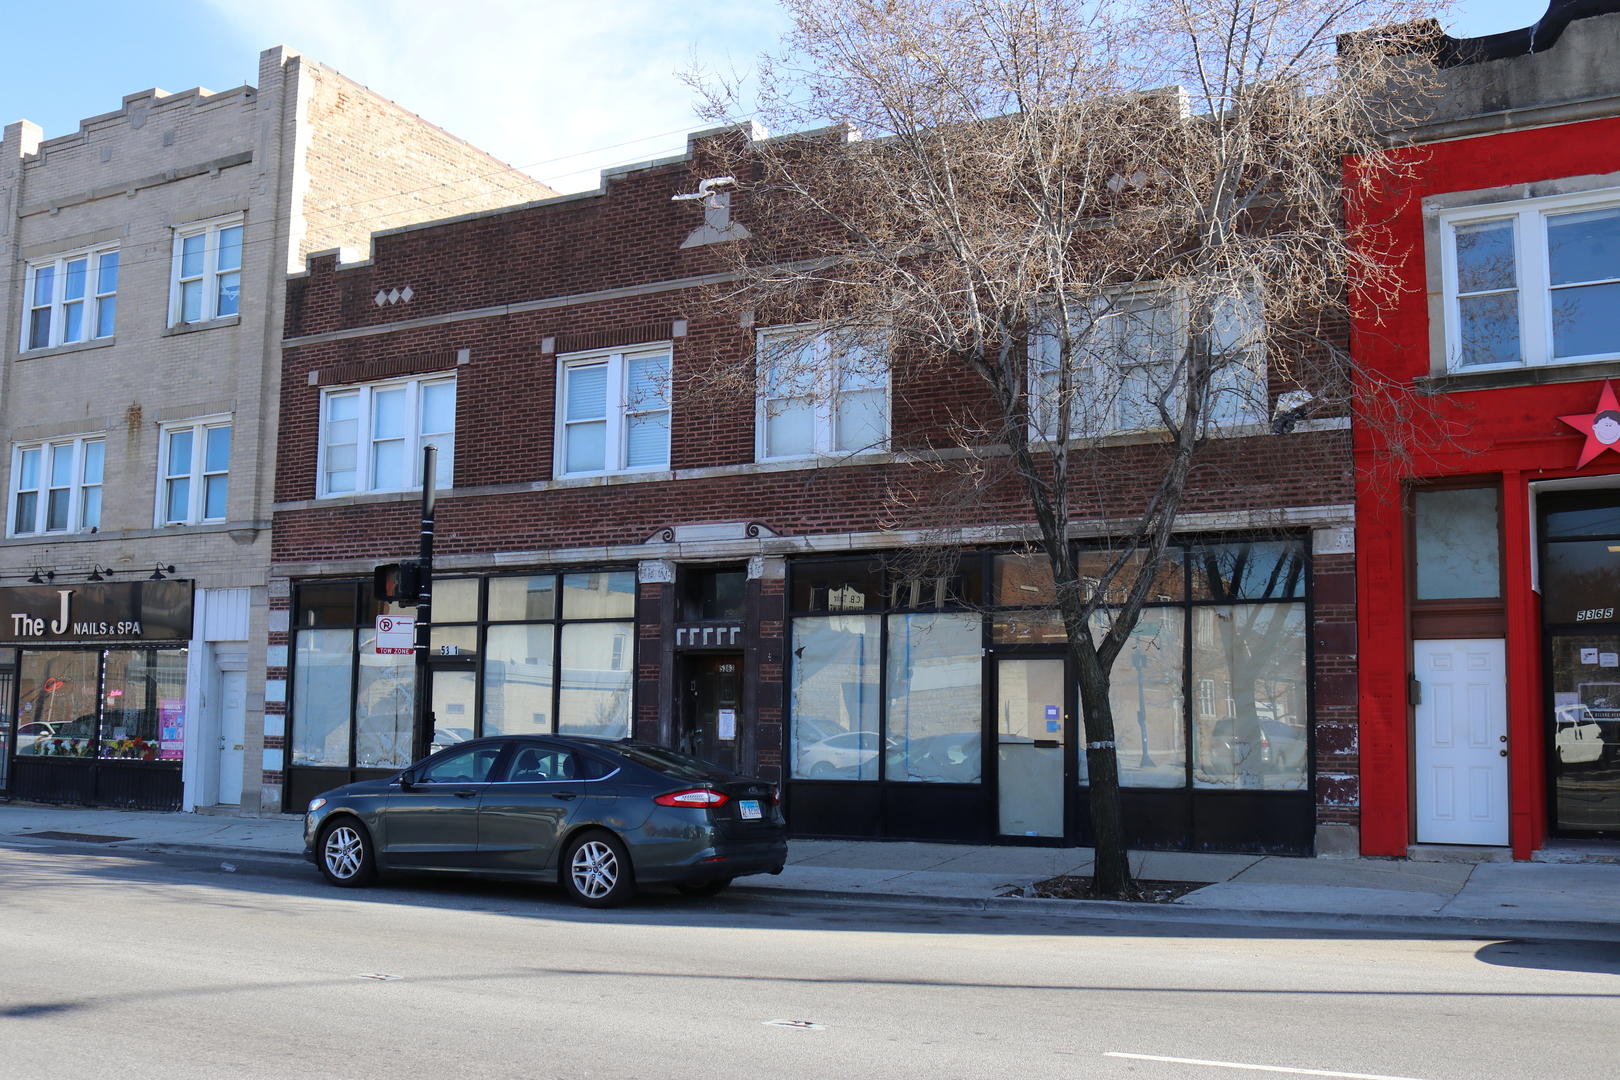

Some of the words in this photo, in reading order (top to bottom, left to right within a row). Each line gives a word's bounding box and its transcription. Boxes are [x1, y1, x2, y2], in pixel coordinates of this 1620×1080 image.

[11, 613, 45, 637] The
[51, 589, 74, 635] J
[73, 621, 107, 635] NAILS
[109, 626, 115, 635] &
[117, 620, 142, 635] SPA
[1577, 608, 1613, 621] 5365
